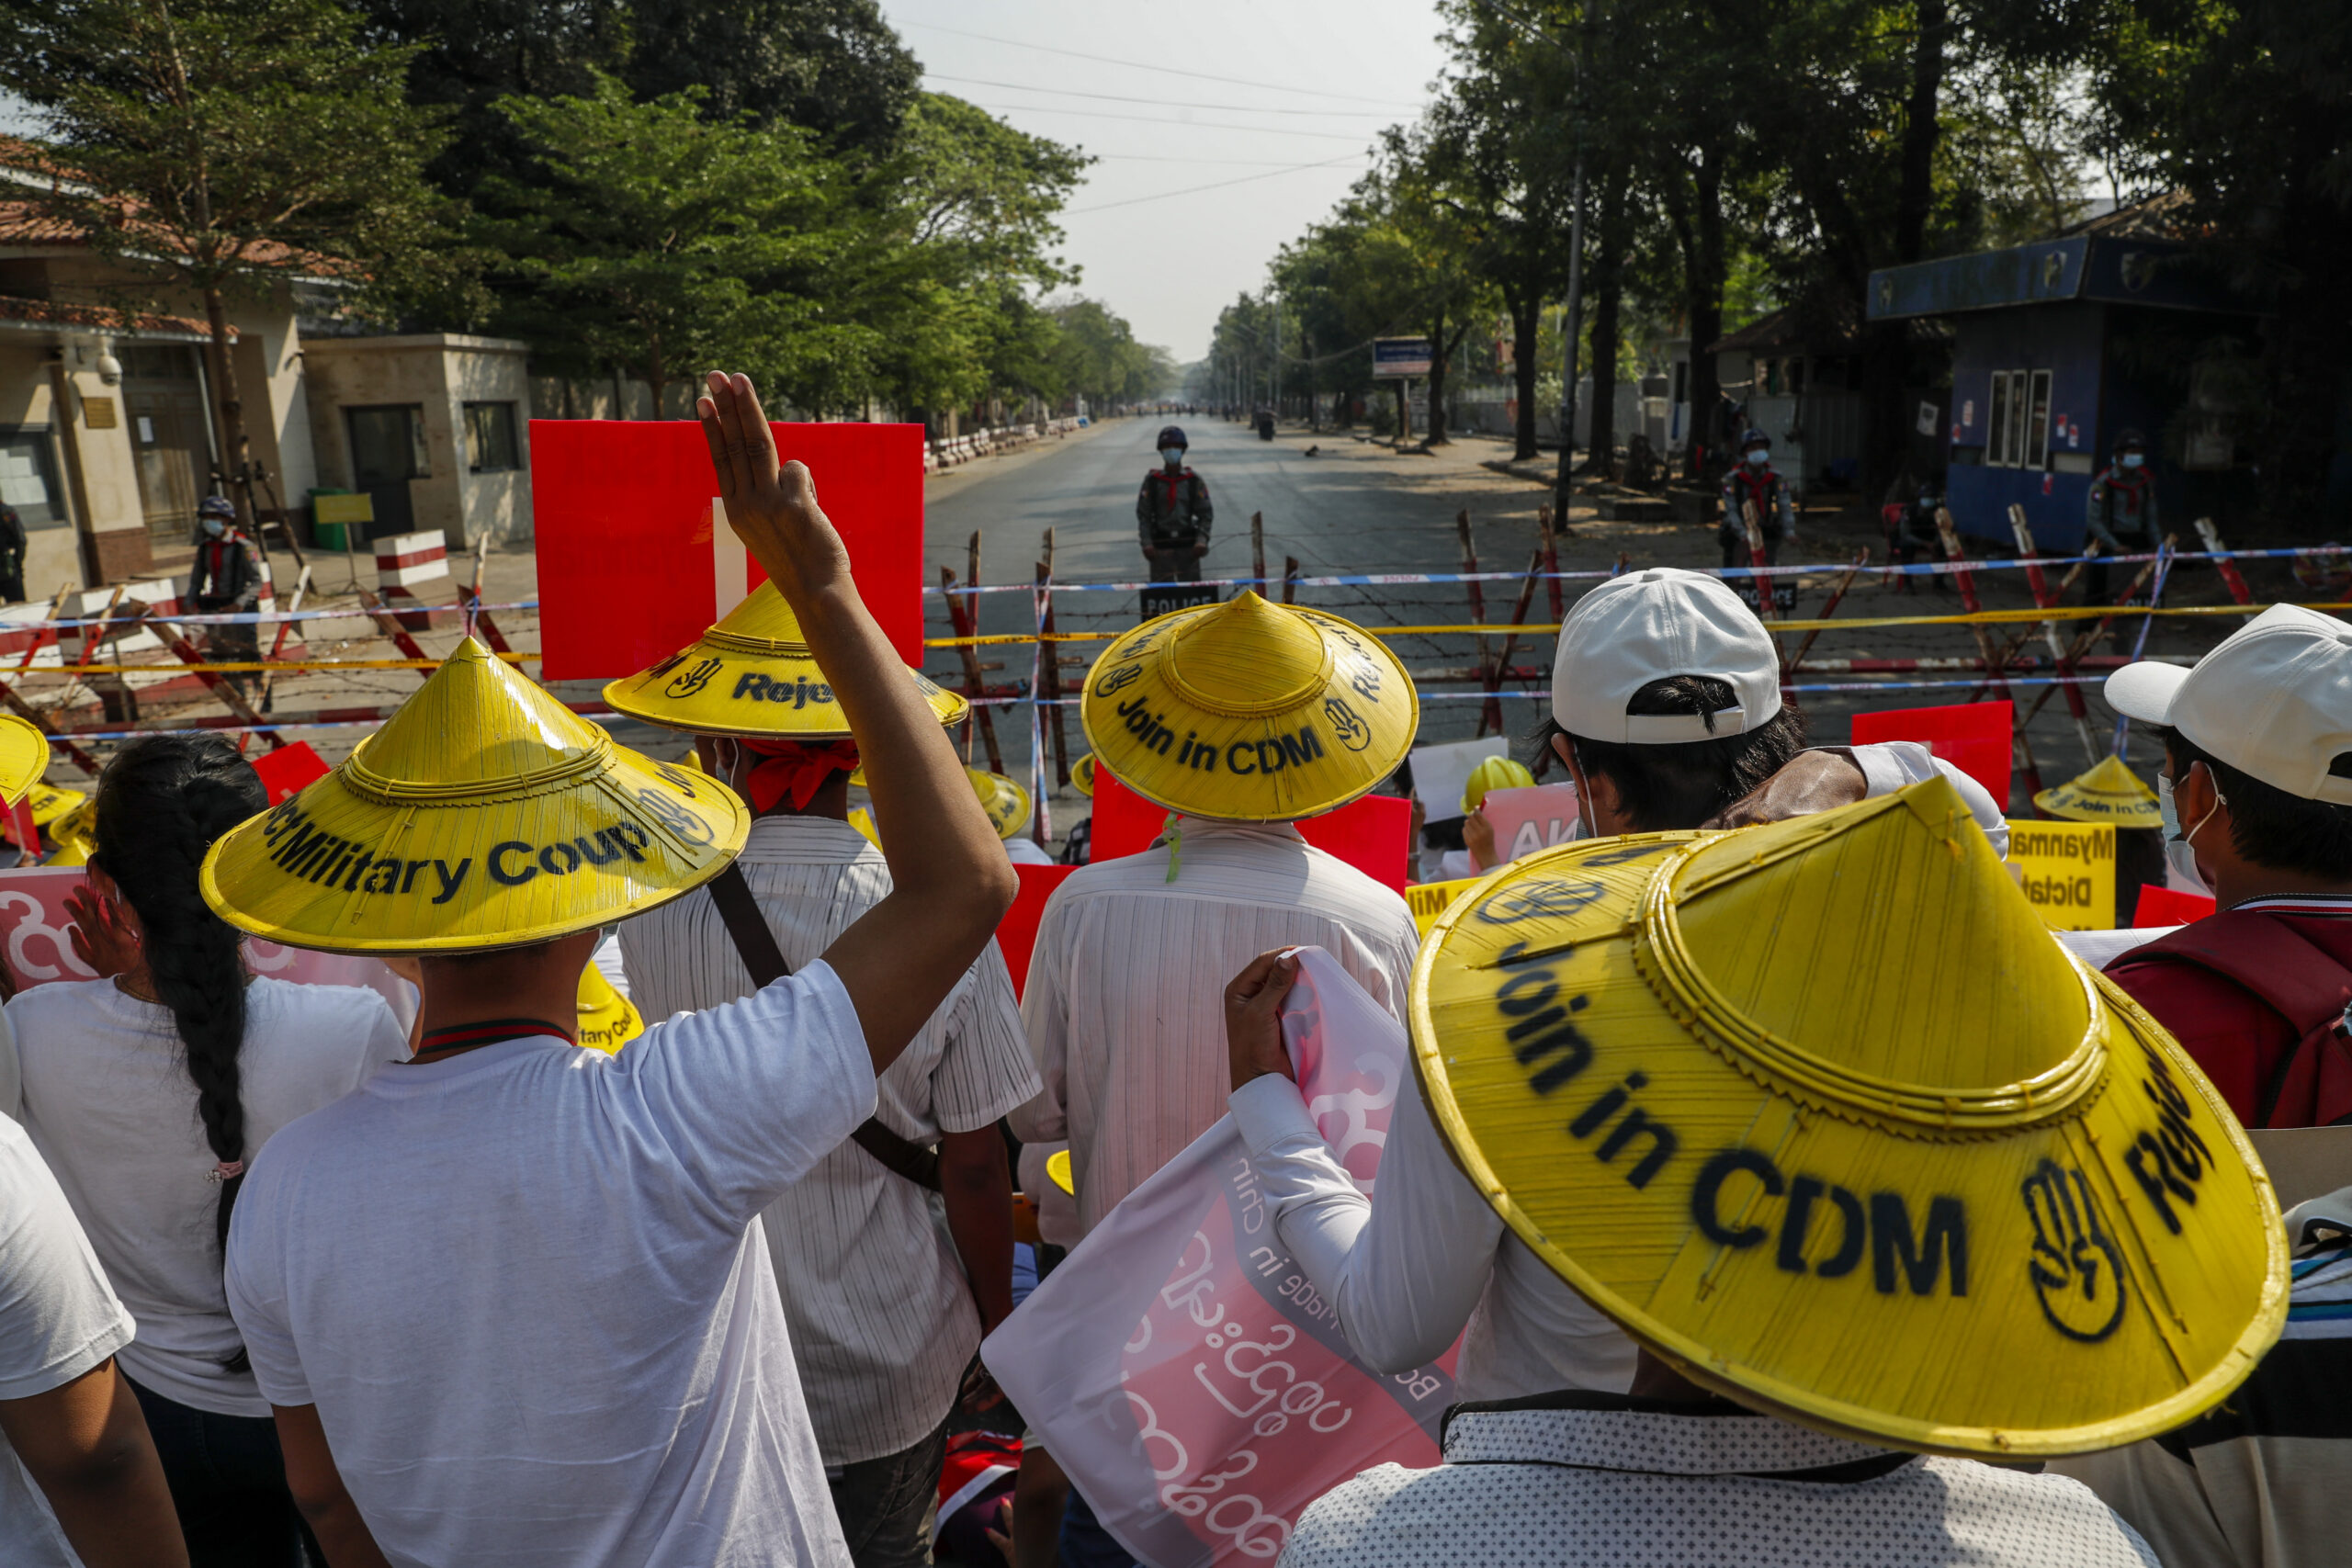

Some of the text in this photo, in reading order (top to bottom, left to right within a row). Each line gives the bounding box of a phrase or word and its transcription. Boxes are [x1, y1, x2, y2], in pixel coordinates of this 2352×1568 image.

[1738, 589, 1793, 606] POICE
[733, 671, 834, 710] Reje
[1116, 695, 1325, 775] Join in CDM
[2073, 799, 2111, 813] Join
[2115, 802, 2132, 815] in
[270, 820, 472, 905] Military
[488, 820, 649, 886] Coup
[1497, 941, 1592, 1095] Join
[1568, 1070, 1680, 1190] in
[1690, 1146, 1969, 1298] CDM
